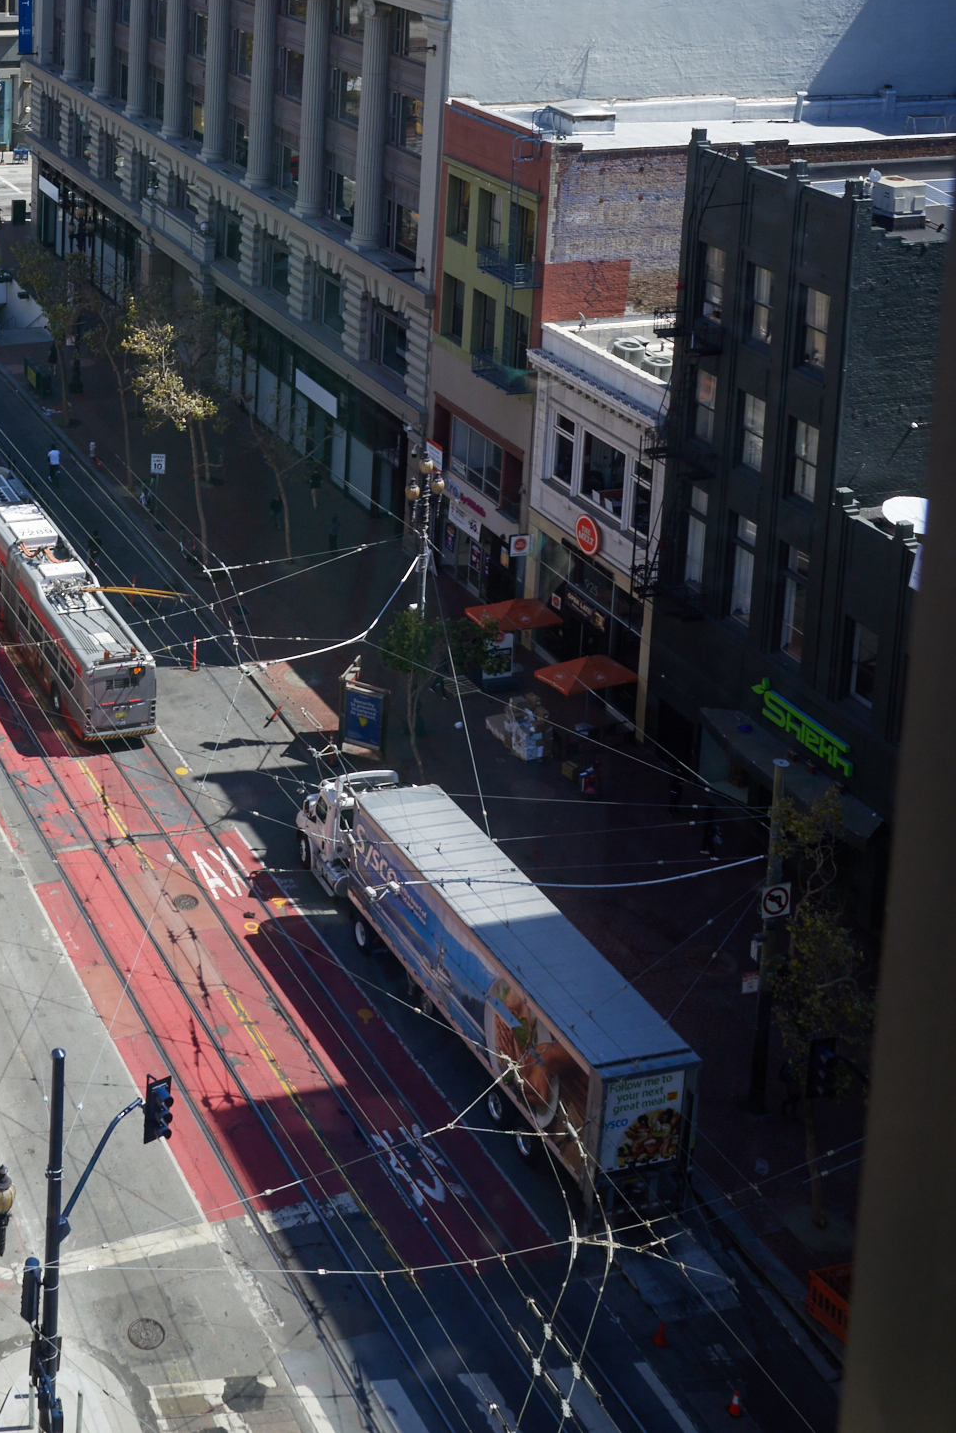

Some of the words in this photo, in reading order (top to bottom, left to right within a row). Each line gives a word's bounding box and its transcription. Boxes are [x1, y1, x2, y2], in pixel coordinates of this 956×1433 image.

[153, 462, 163, 470] 10
[578, 531, 595, 546] MELT
[581, 525, 592, 537] THE
[584, 578, 599, 597] 925
[609, 1079, 642, 1093] Follow
[644, 1077, 660, 1087] me
[662, 1075, 673, 1083] to
[617, 1091, 639, 1104] your
[642, 1086, 664, 1098] next
[613, 1101, 639, 1115] great
[641, 1095, 666, 1107] meal
